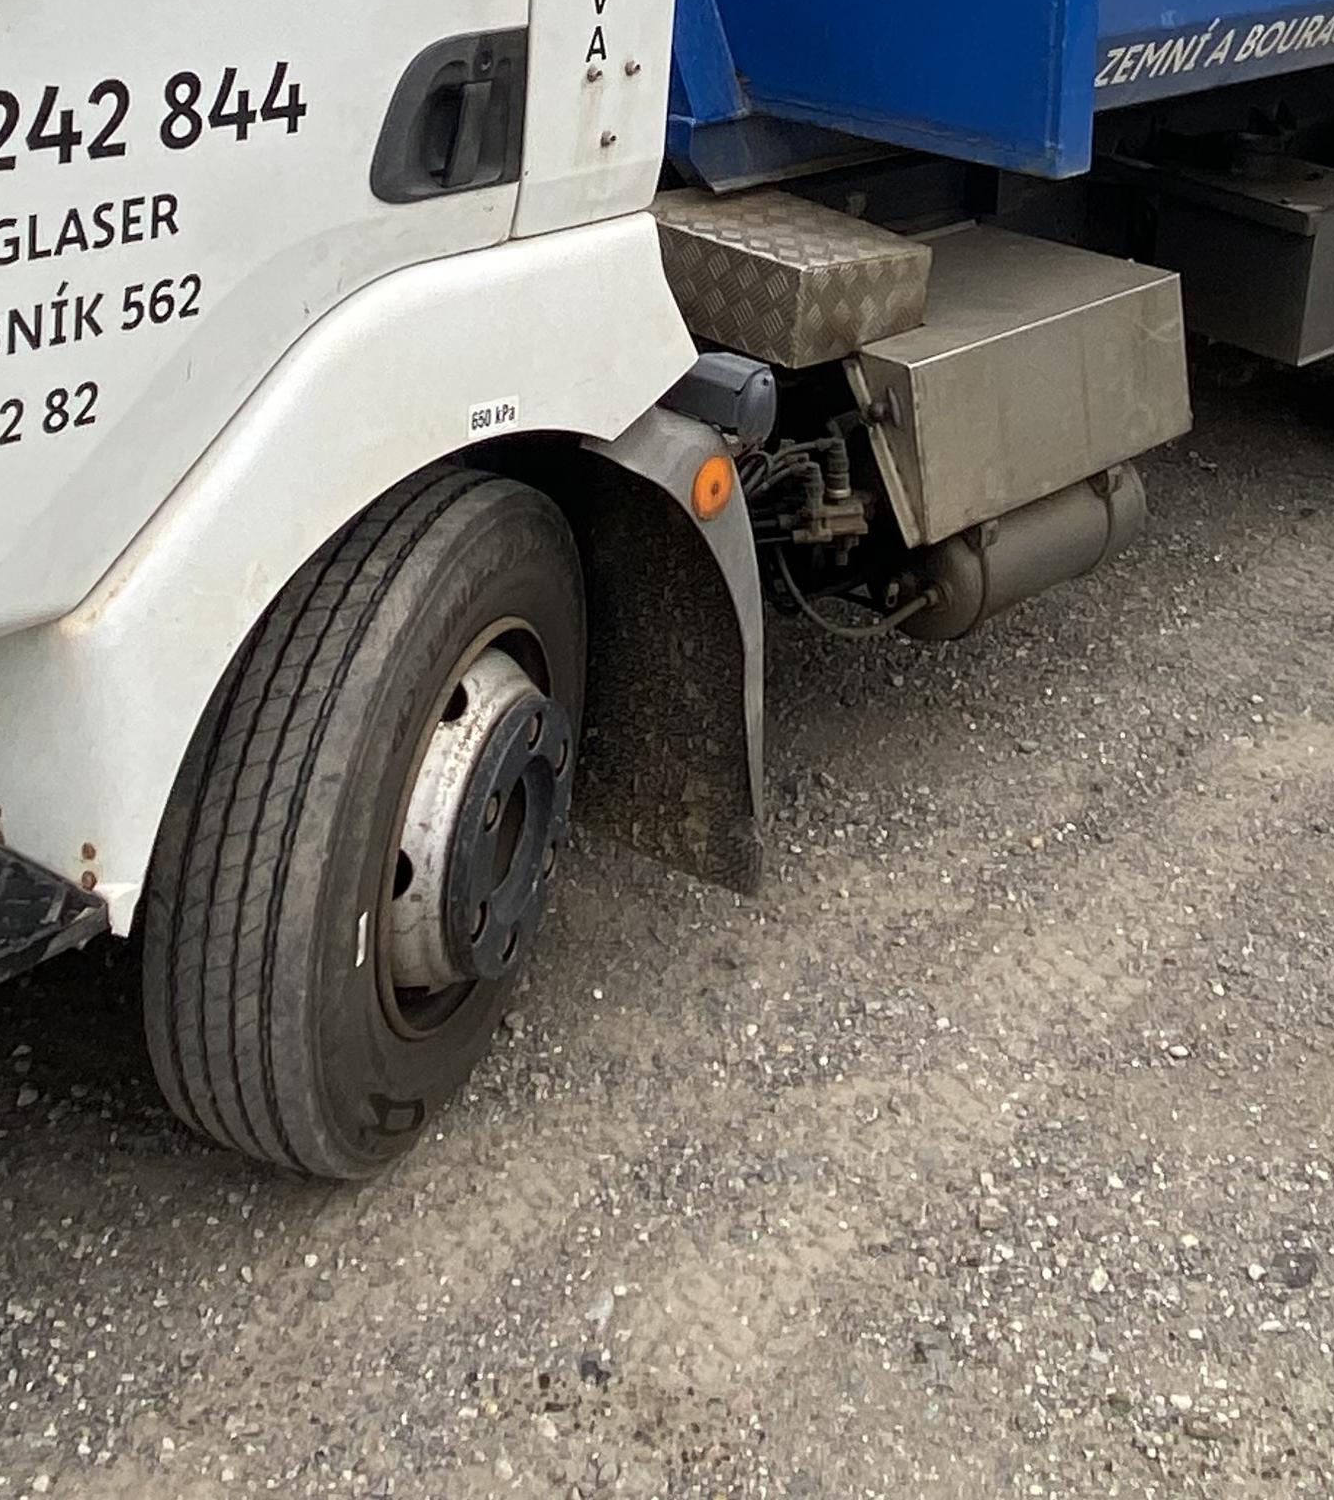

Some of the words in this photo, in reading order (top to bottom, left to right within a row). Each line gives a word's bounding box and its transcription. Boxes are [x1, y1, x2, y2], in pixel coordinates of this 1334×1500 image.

[1093, 17, 1222, 88] ZEMNÍ
[1203, 28, 1237, 69] A
[158, 60, 308, 150] 844
[120, 273, 203, 333] 562
[42, 380, 101, 435] 82
[471, 408, 492, 431] 650
[494, 403, 516, 425] kPa
